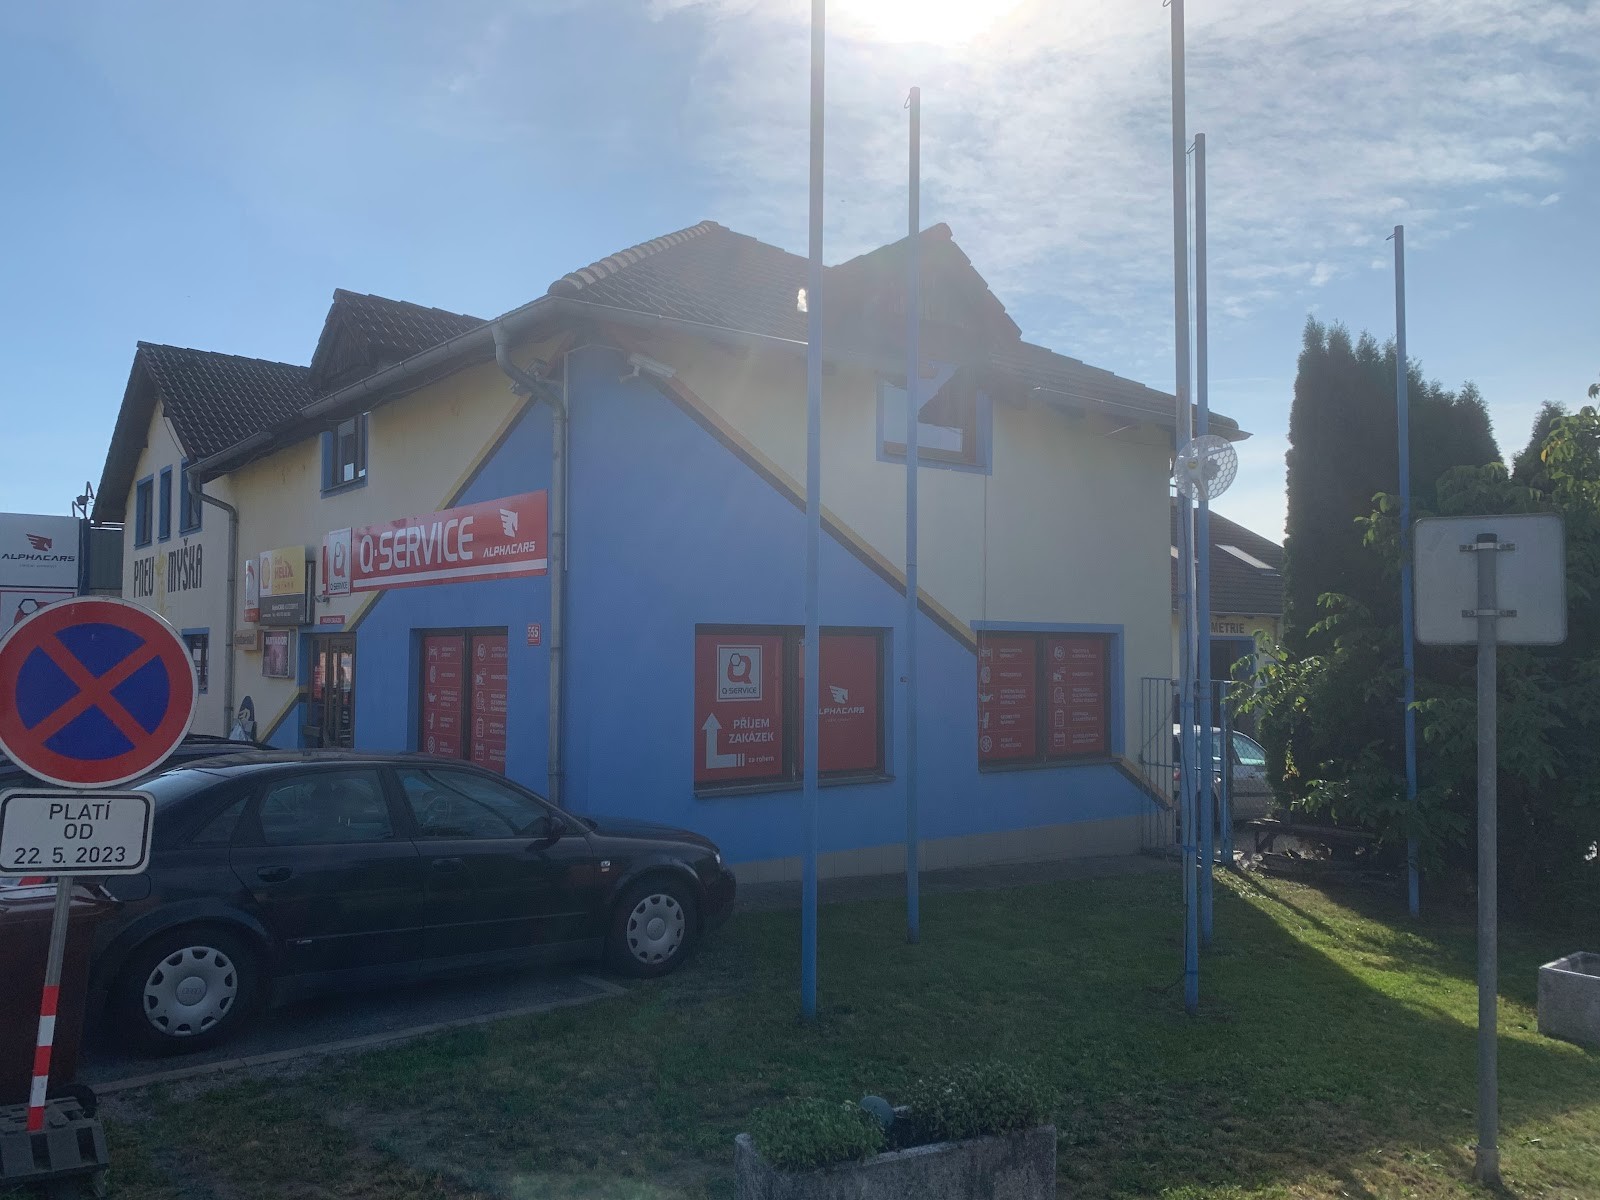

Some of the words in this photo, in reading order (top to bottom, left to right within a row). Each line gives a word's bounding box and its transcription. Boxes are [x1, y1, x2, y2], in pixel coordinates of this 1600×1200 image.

[483, 541, 536, 557] ALPHACARS
[1, 553, 76, 562] ALPHACARS
[133, 556, 155, 598] PNEU
[167, 537, 203, 593] MYŠKA
[728, 686, 757, 695] SERVICE
[818, 706, 865, 715] LPHACARS
[733, 717, 770, 730] PŘÍJEM
[729, 731, 775, 744] ZAKÁZEK
[756, 755, 775, 763] rohem
[49, 800, 112, 820] PLATÍ
[64, 823, 93, 840] OD
[14, 847, 42, 864] 22.
[52, 846, 66, 863] 5.
[75, 846, 126, 863] 2023
